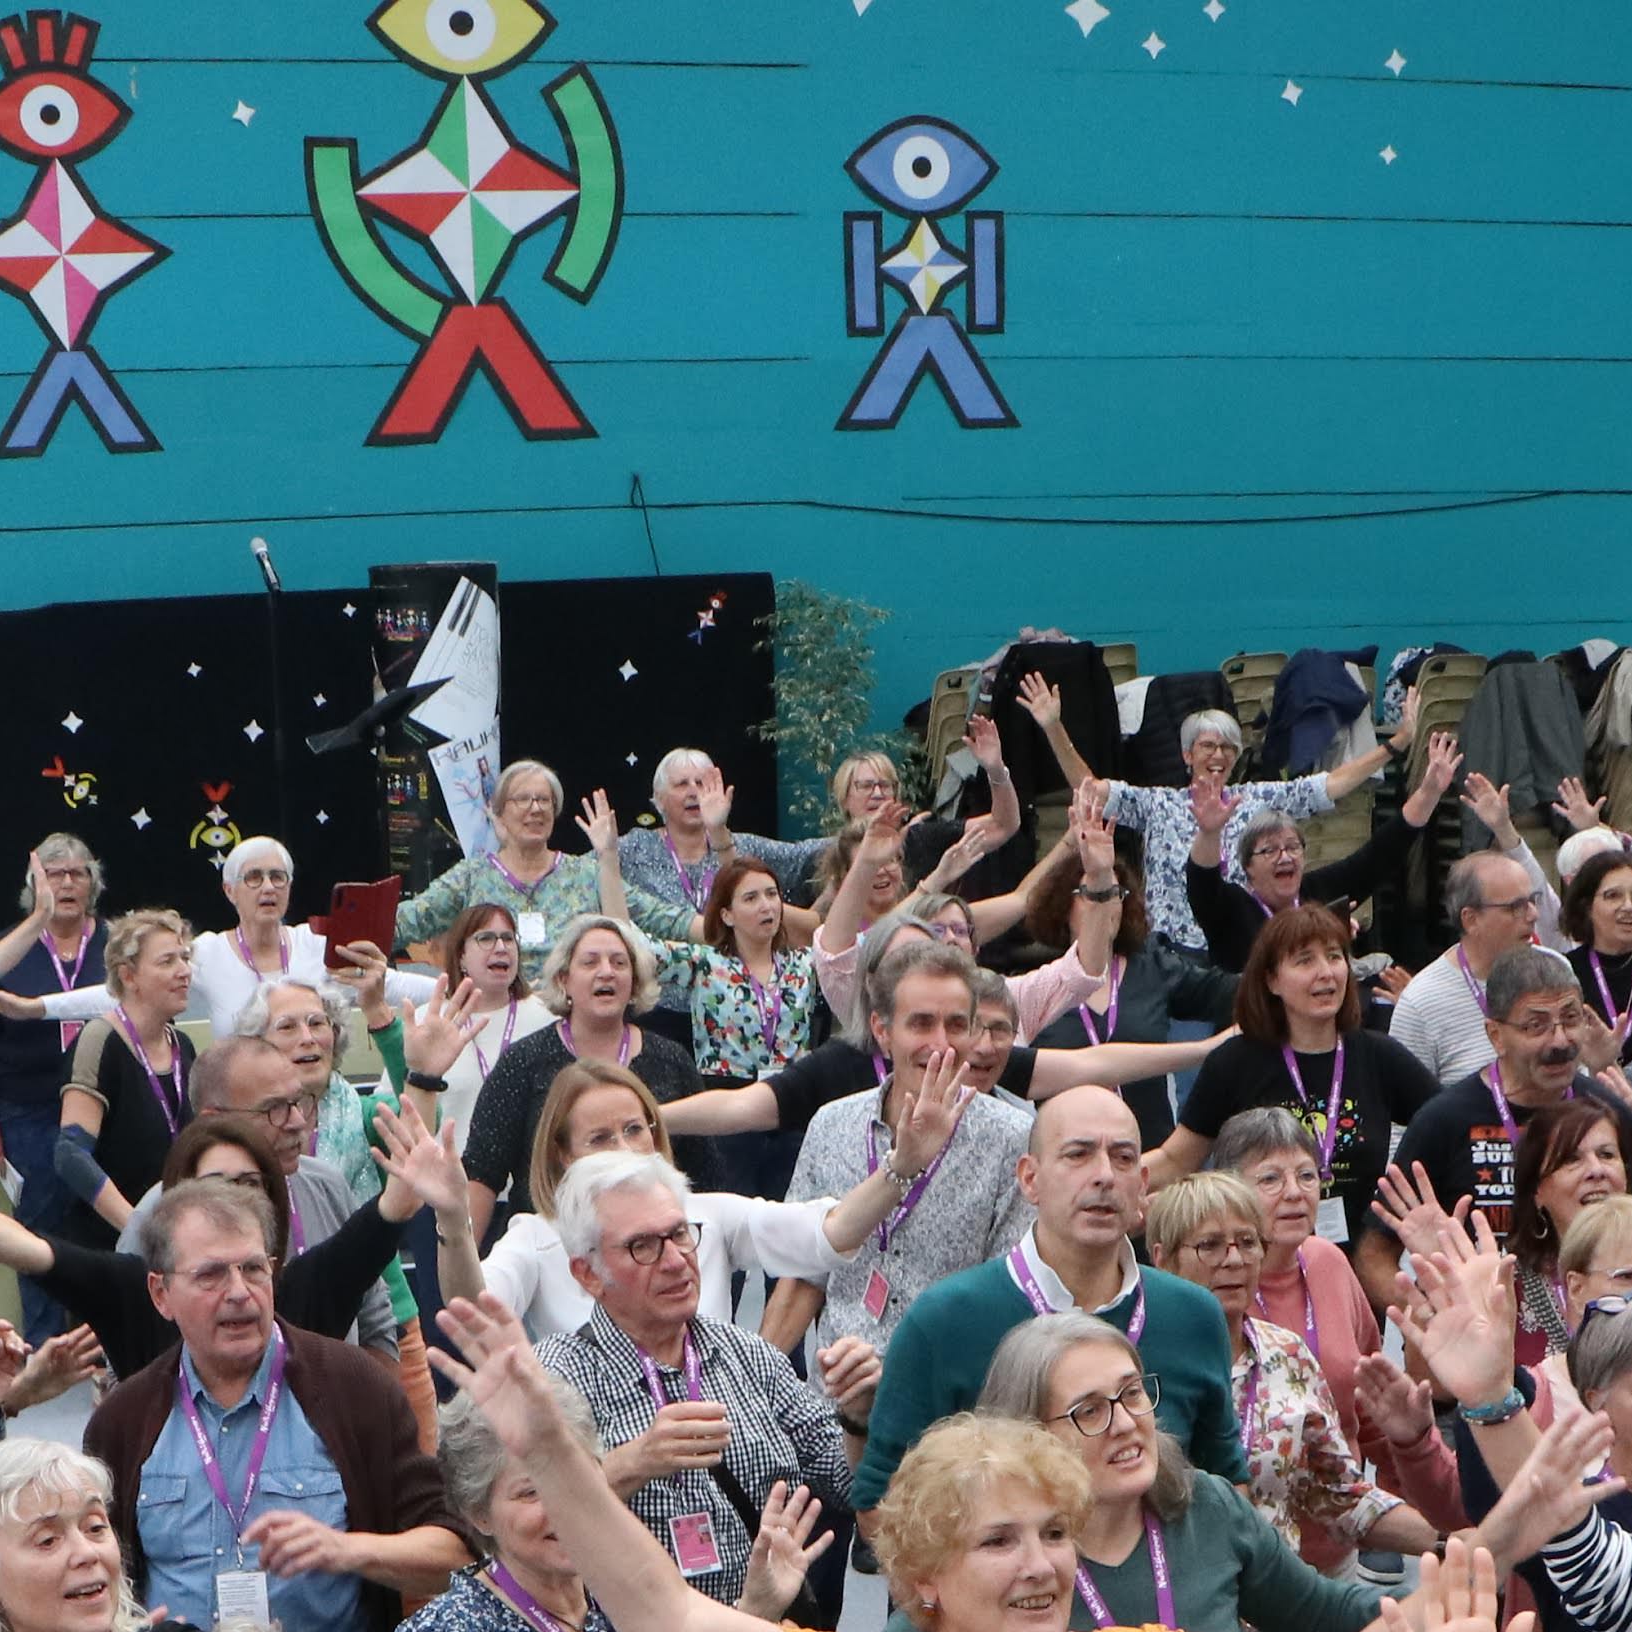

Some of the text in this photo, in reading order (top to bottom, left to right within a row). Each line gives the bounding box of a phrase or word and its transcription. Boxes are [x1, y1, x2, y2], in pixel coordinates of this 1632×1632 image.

[1471, 1141, 1513, 1152] Jus
[1472, 1151, 1516, 1164] SUN
[1475, 1184, 1516, 1196] YOU
